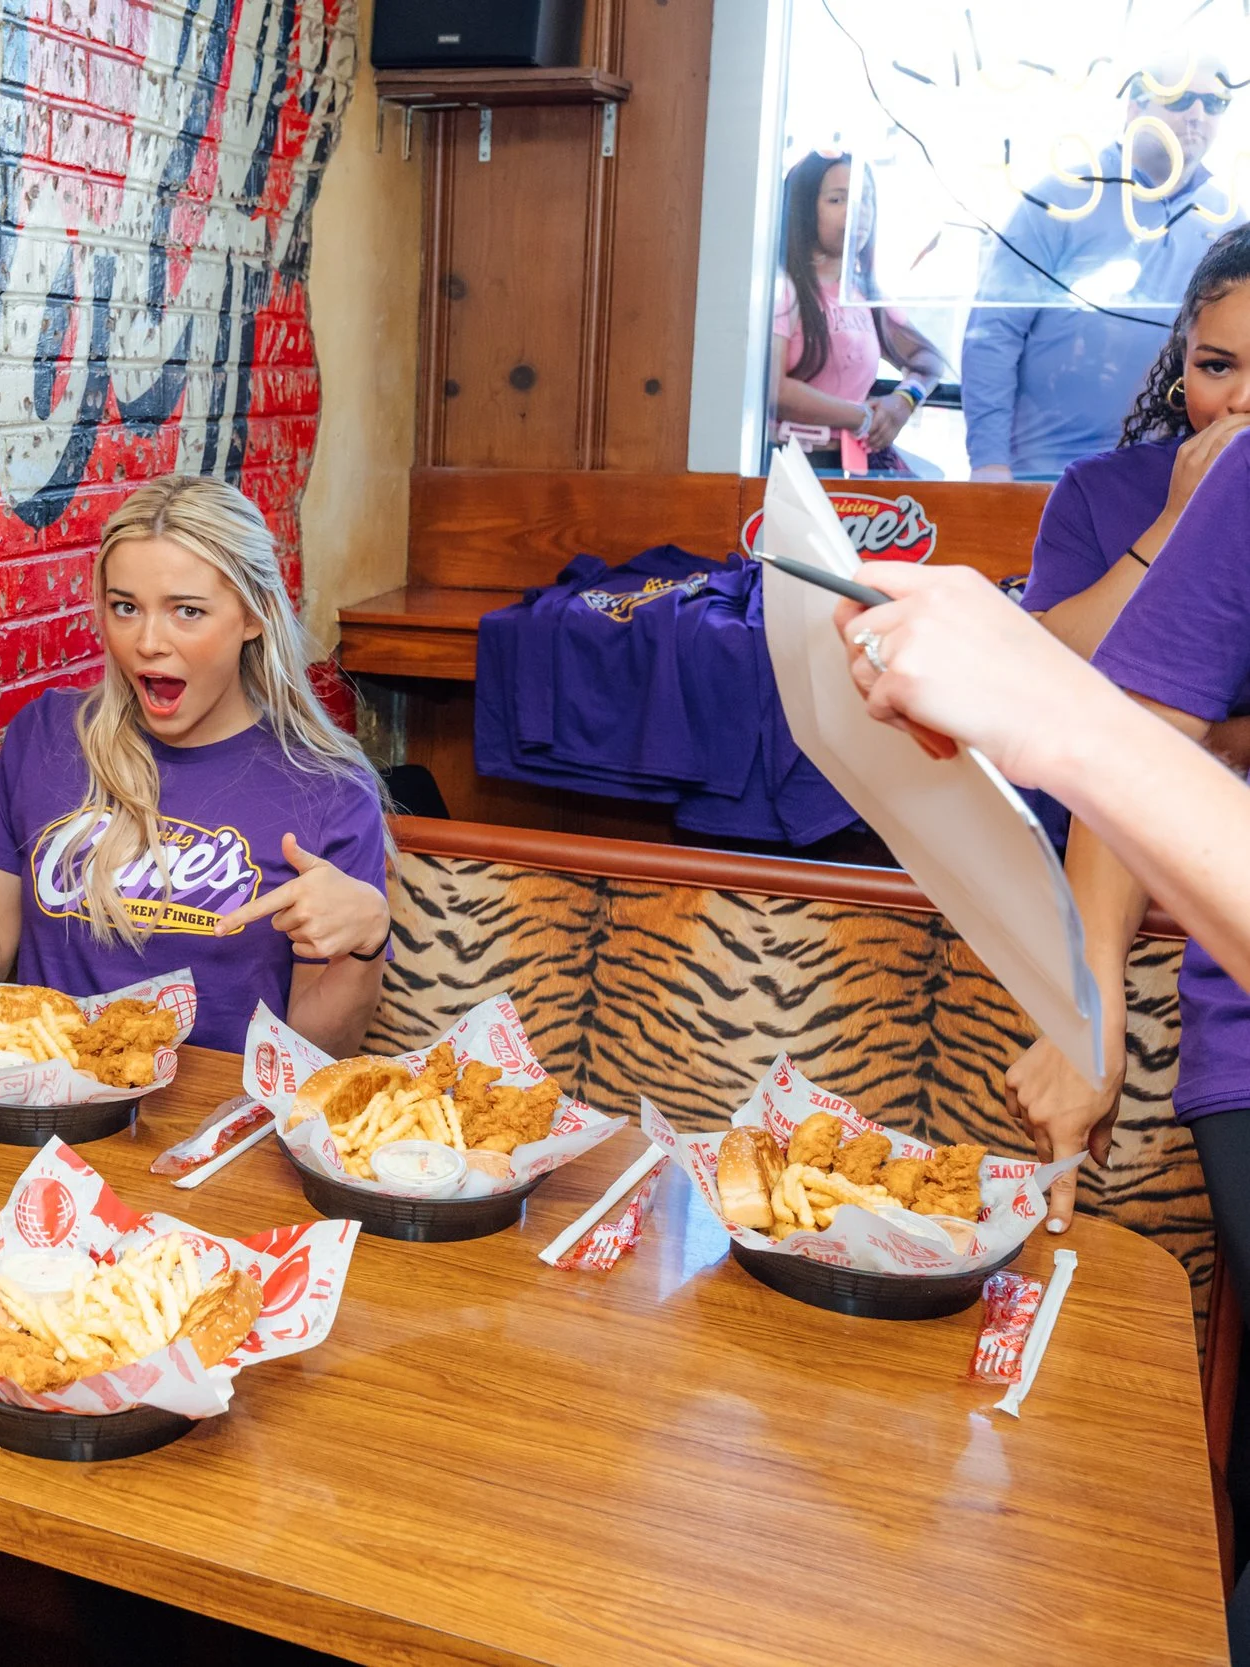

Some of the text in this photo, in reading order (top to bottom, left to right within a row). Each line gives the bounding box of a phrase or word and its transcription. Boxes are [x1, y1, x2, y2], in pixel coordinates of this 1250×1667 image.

[833, 500, 879, 518] aising
[844, 498, 933, 551] ne's
[282, 1061, 297, 1094] ONE
